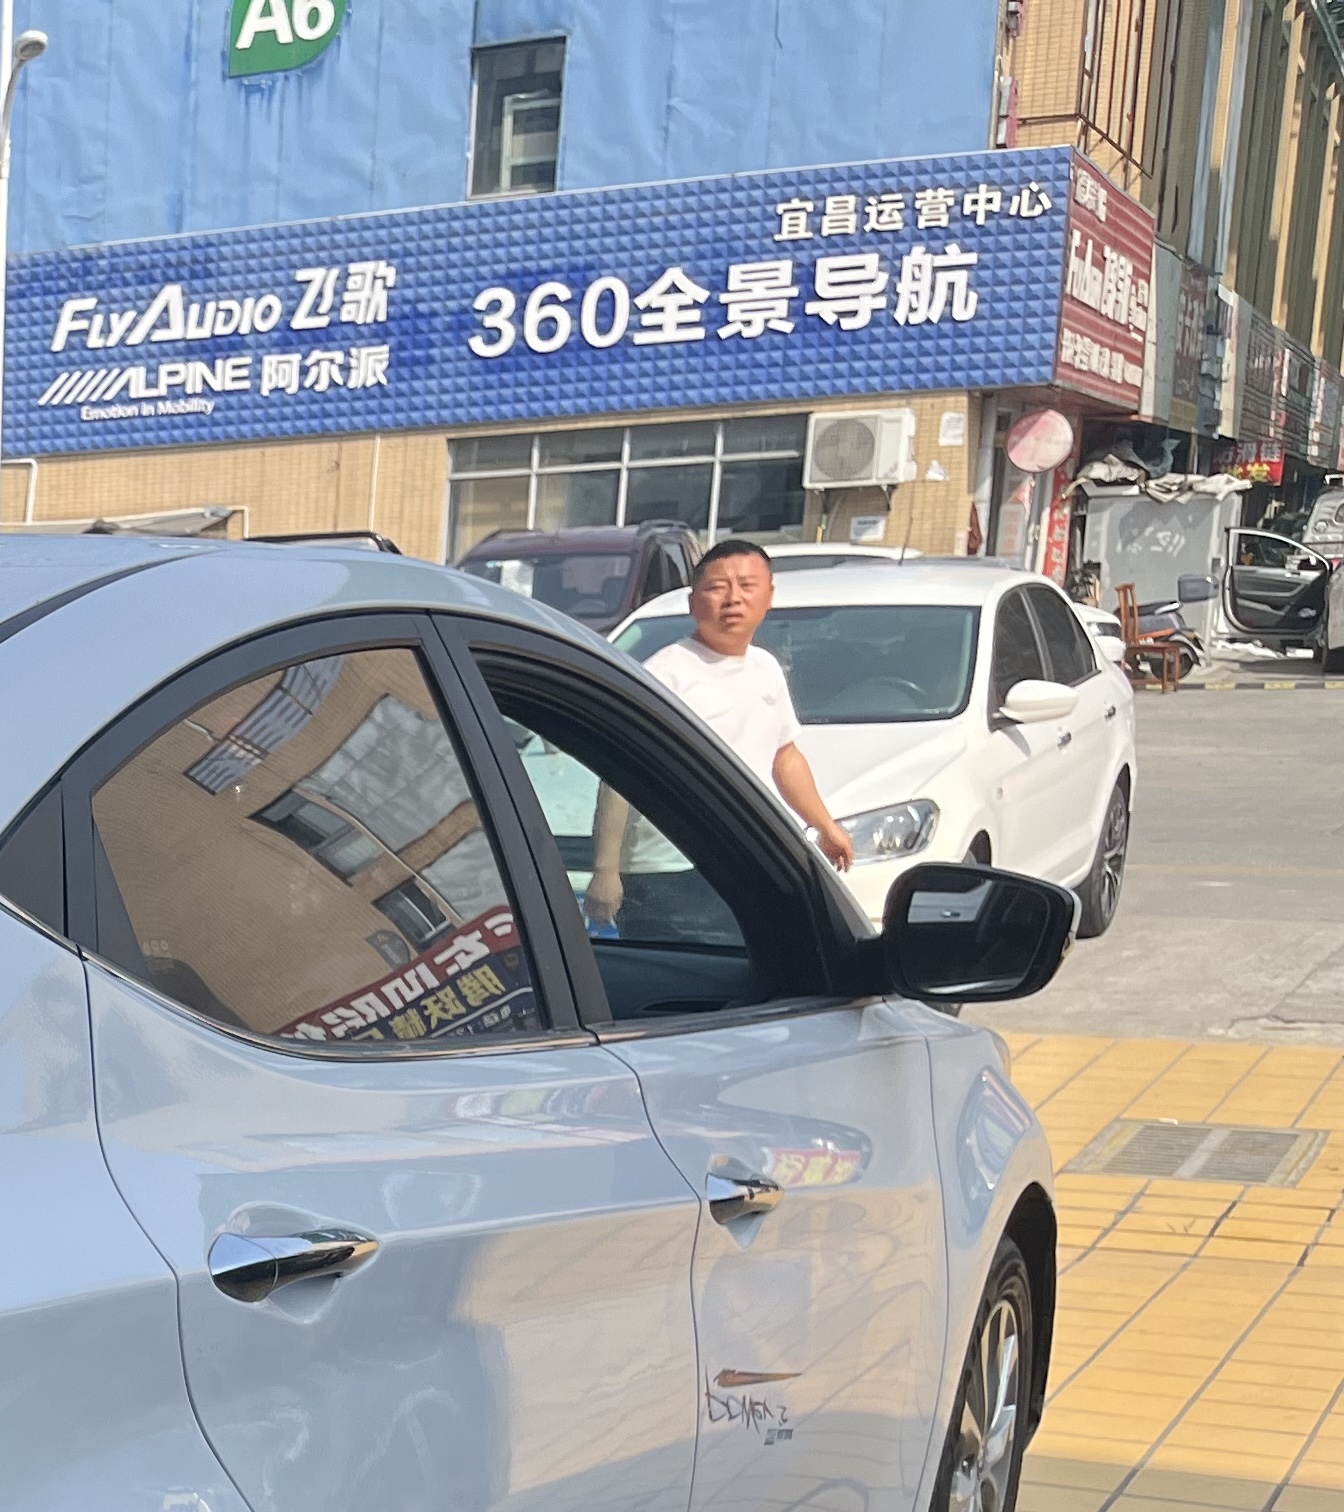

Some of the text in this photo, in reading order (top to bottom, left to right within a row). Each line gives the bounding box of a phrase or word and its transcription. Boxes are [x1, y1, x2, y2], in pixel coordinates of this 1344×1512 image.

[235, 0, 335, 49] A6
[772, 182, 1053, 243] 宜昌运营中心
[290, 260, 397, 331] 飞歌
[467, 243, 979, 360] 360全景导航
[261, 345, 391, 397] 阿尔派
[156, 396, 215, 416] Mobility
